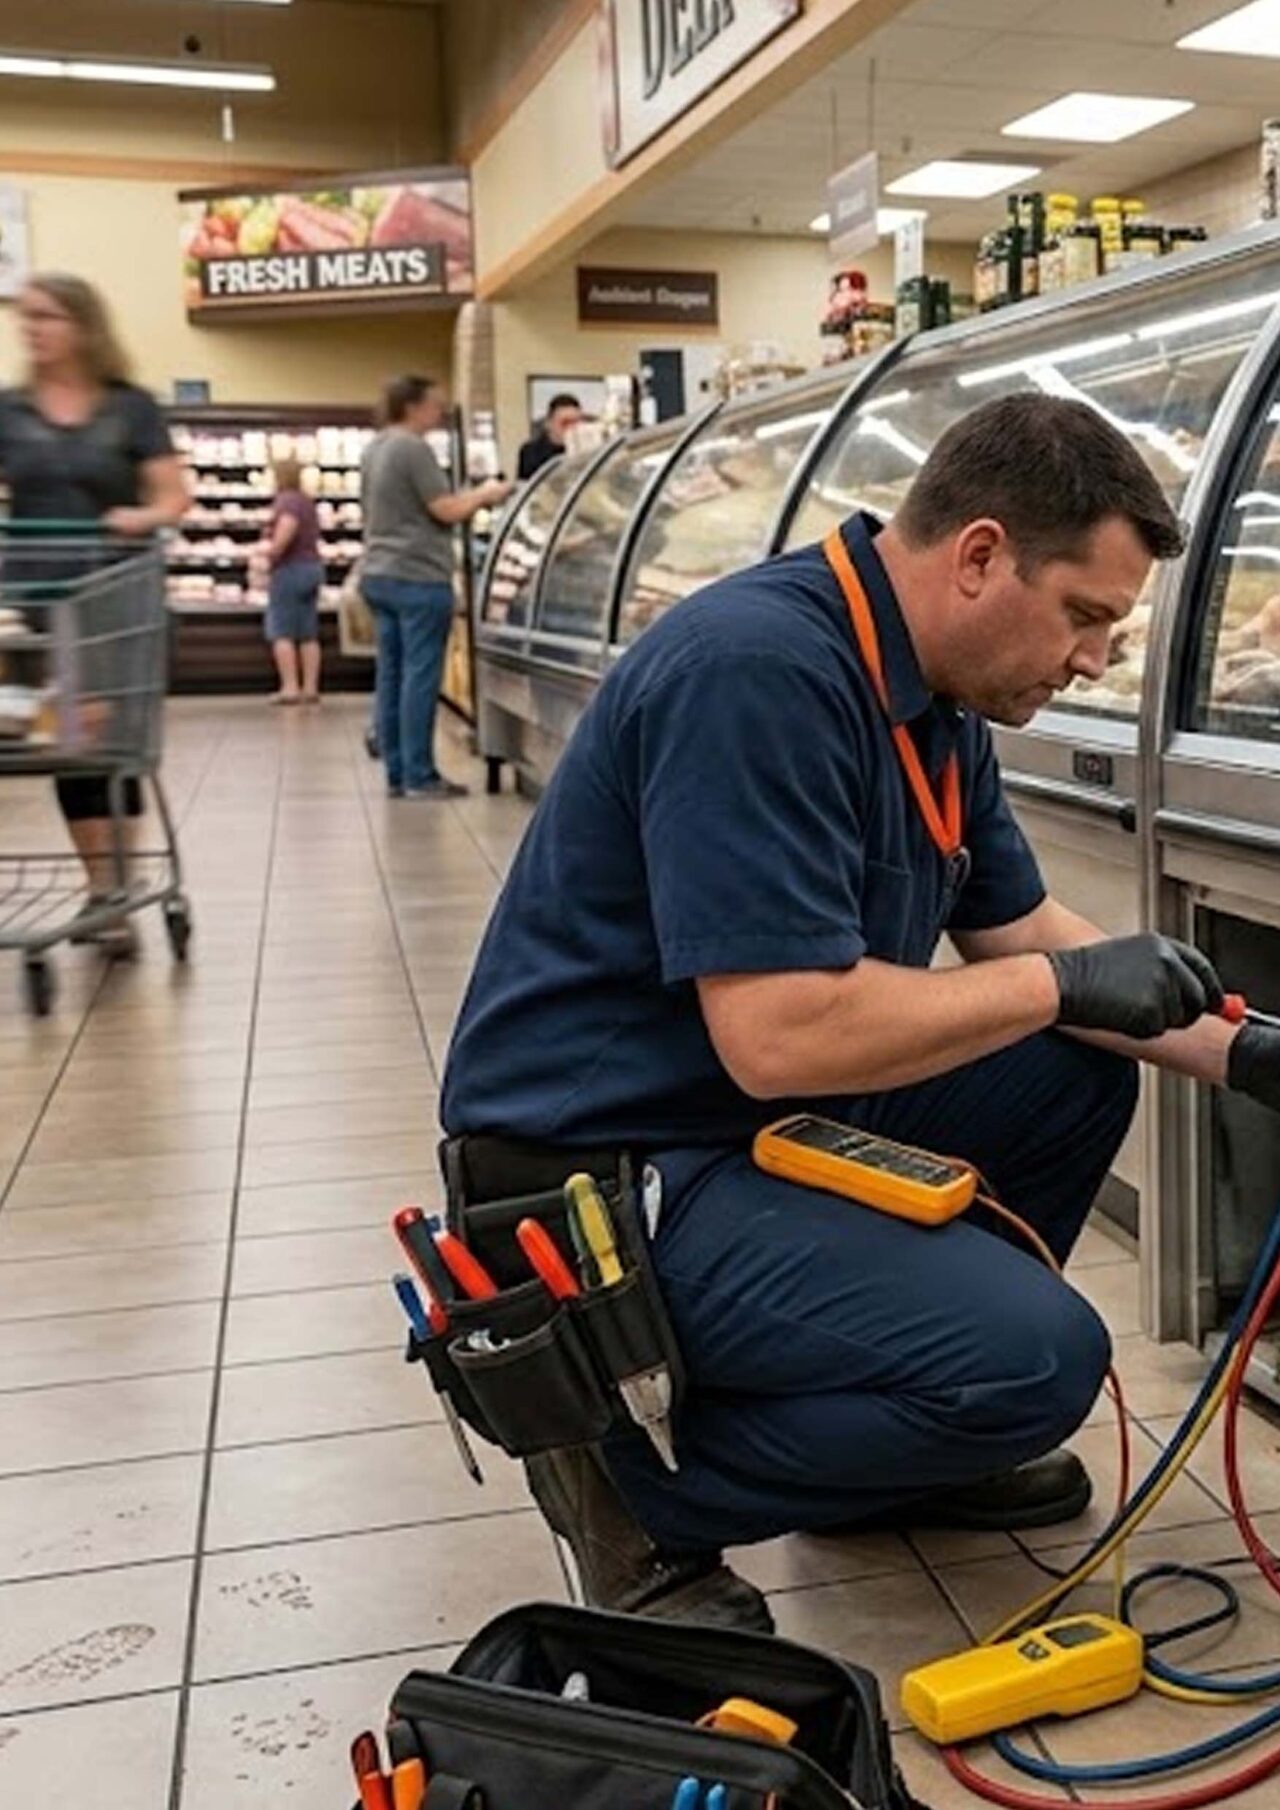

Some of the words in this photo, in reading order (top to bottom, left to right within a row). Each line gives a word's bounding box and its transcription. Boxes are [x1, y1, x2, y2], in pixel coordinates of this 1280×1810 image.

[641, 0, 735, 101] DEL
[208, 257, 309, 294] FRESH
[318, 249, 428, 287] MEATS
